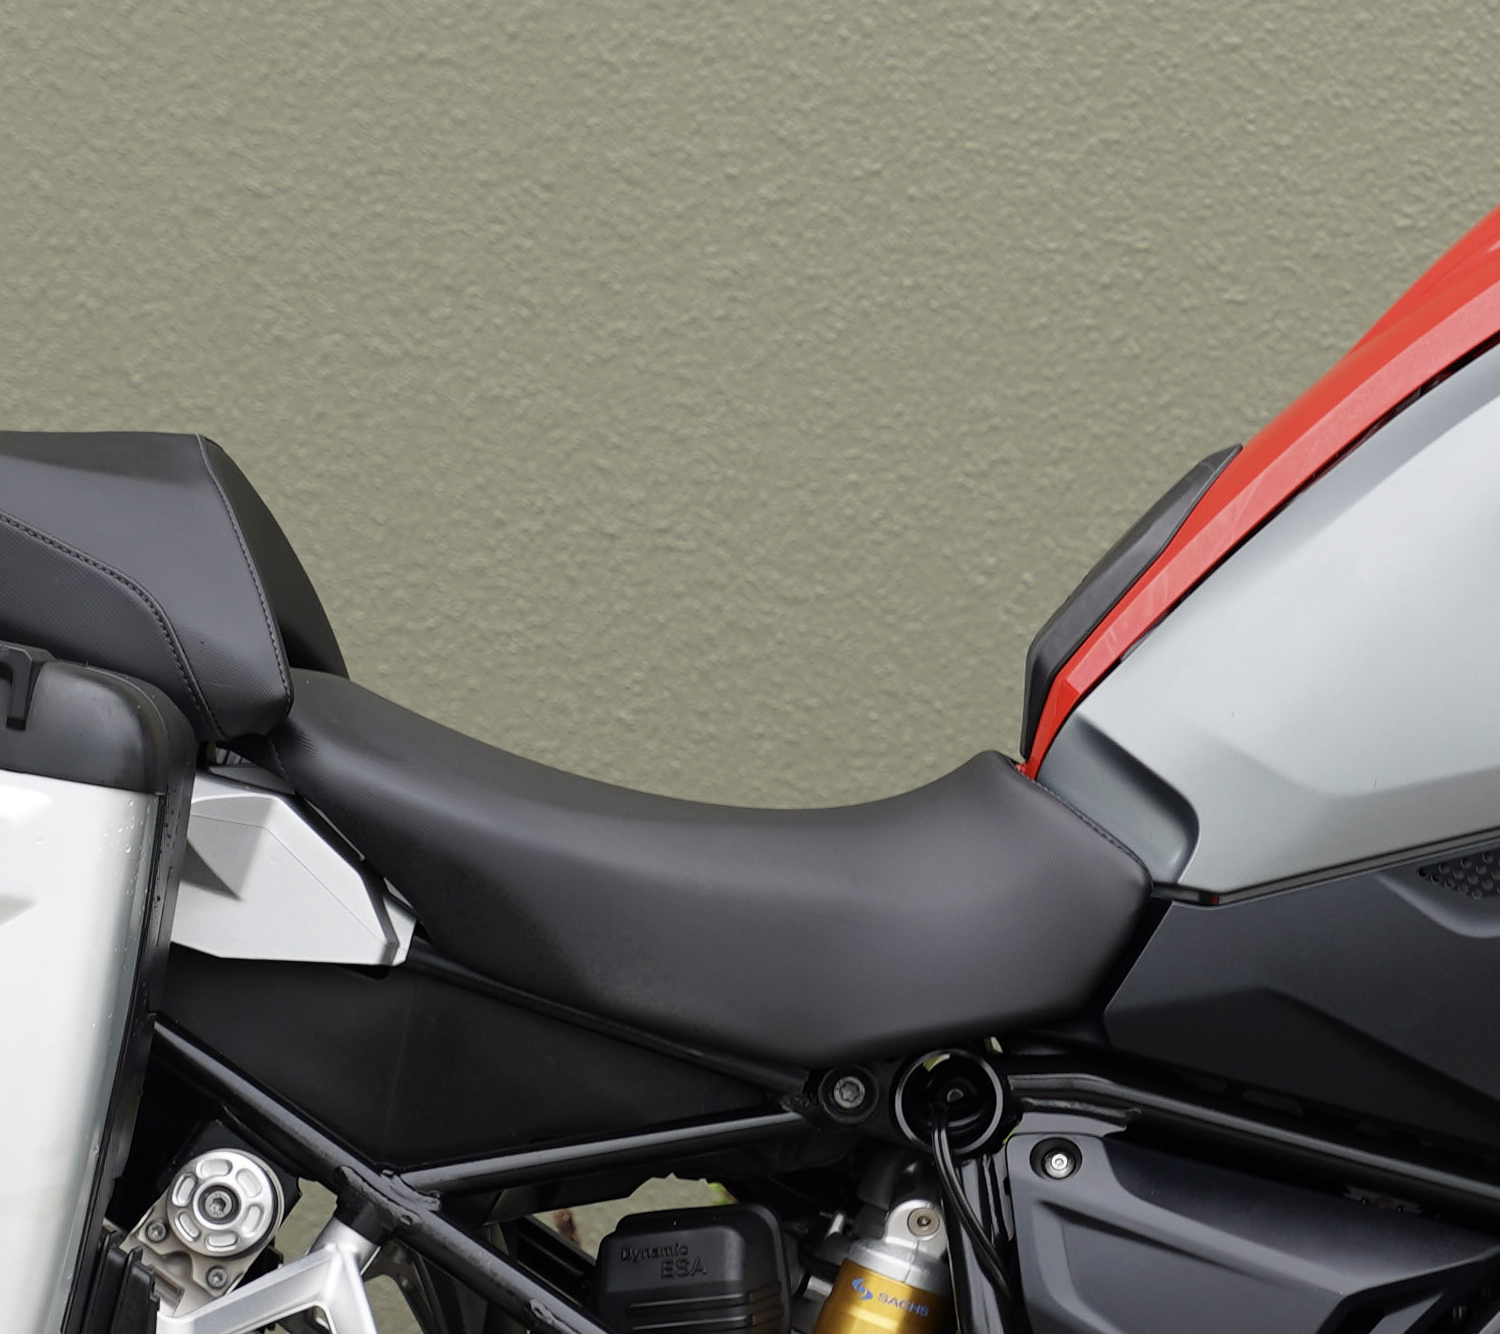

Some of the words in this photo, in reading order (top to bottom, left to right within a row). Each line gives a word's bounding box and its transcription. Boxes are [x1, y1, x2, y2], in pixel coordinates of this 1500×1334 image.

[620, 1242, 689, 1264] Dynamic
[660, 1257, 708, 1279] ESA
[877, 1291, 930, 1317] SACHS
